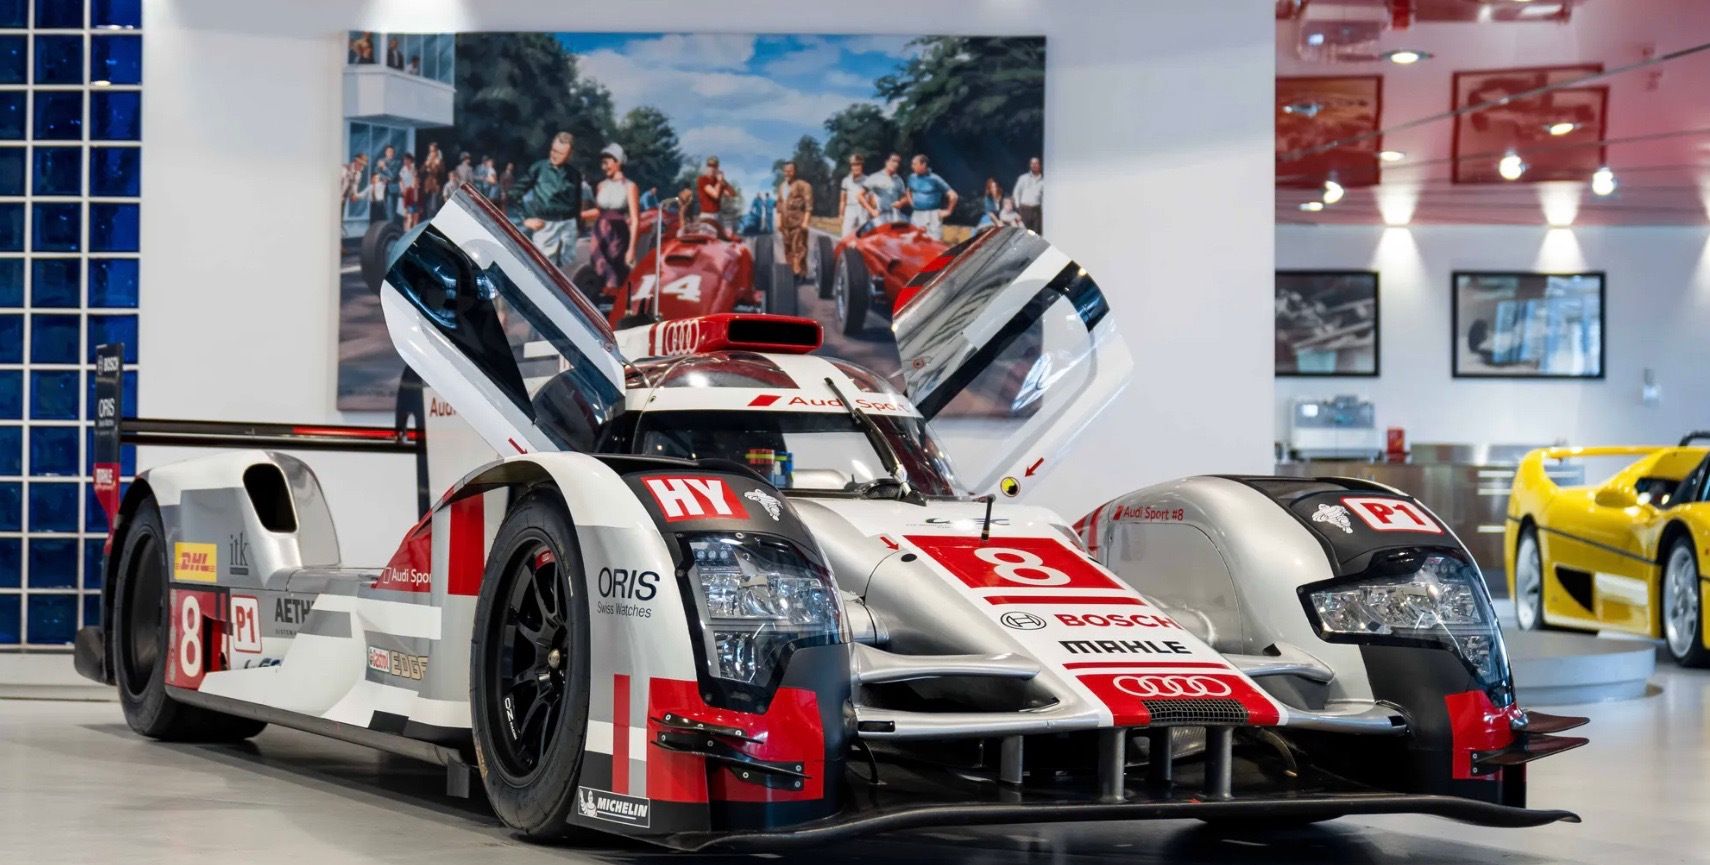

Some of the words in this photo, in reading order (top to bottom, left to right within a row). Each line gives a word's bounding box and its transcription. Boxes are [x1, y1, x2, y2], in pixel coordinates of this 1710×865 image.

[630, 273, 702, 302] 14
[789, 396, 845, 407] Aud
[646, 478, 732, 517] HY
[1123, 505, 1143, 518] Audi
[1145, 506, 1169, 523] Sport
[1172, 508, 1184, 521] #8
[1360, 502, 1427, 525] P1
[229, 531, 248, 566] itk
[180, 551, 209, 572] DHL
[973, 547, 1071, 586] 8
[391, 567, 409, 583] Audi
[598, 566, 660, 602] ORIS
[596, 600, 614, 615] Swiss
[615, 602, 652, 618] Watches
[235, 605, 256, 643] P1
[1054, 613, 1184, 630] BOSCH
[180, 595, 202, 678] 8
[1058, 640, 1193, 654] MAHLE
[597, 797, 648, 818] MICHELIN
